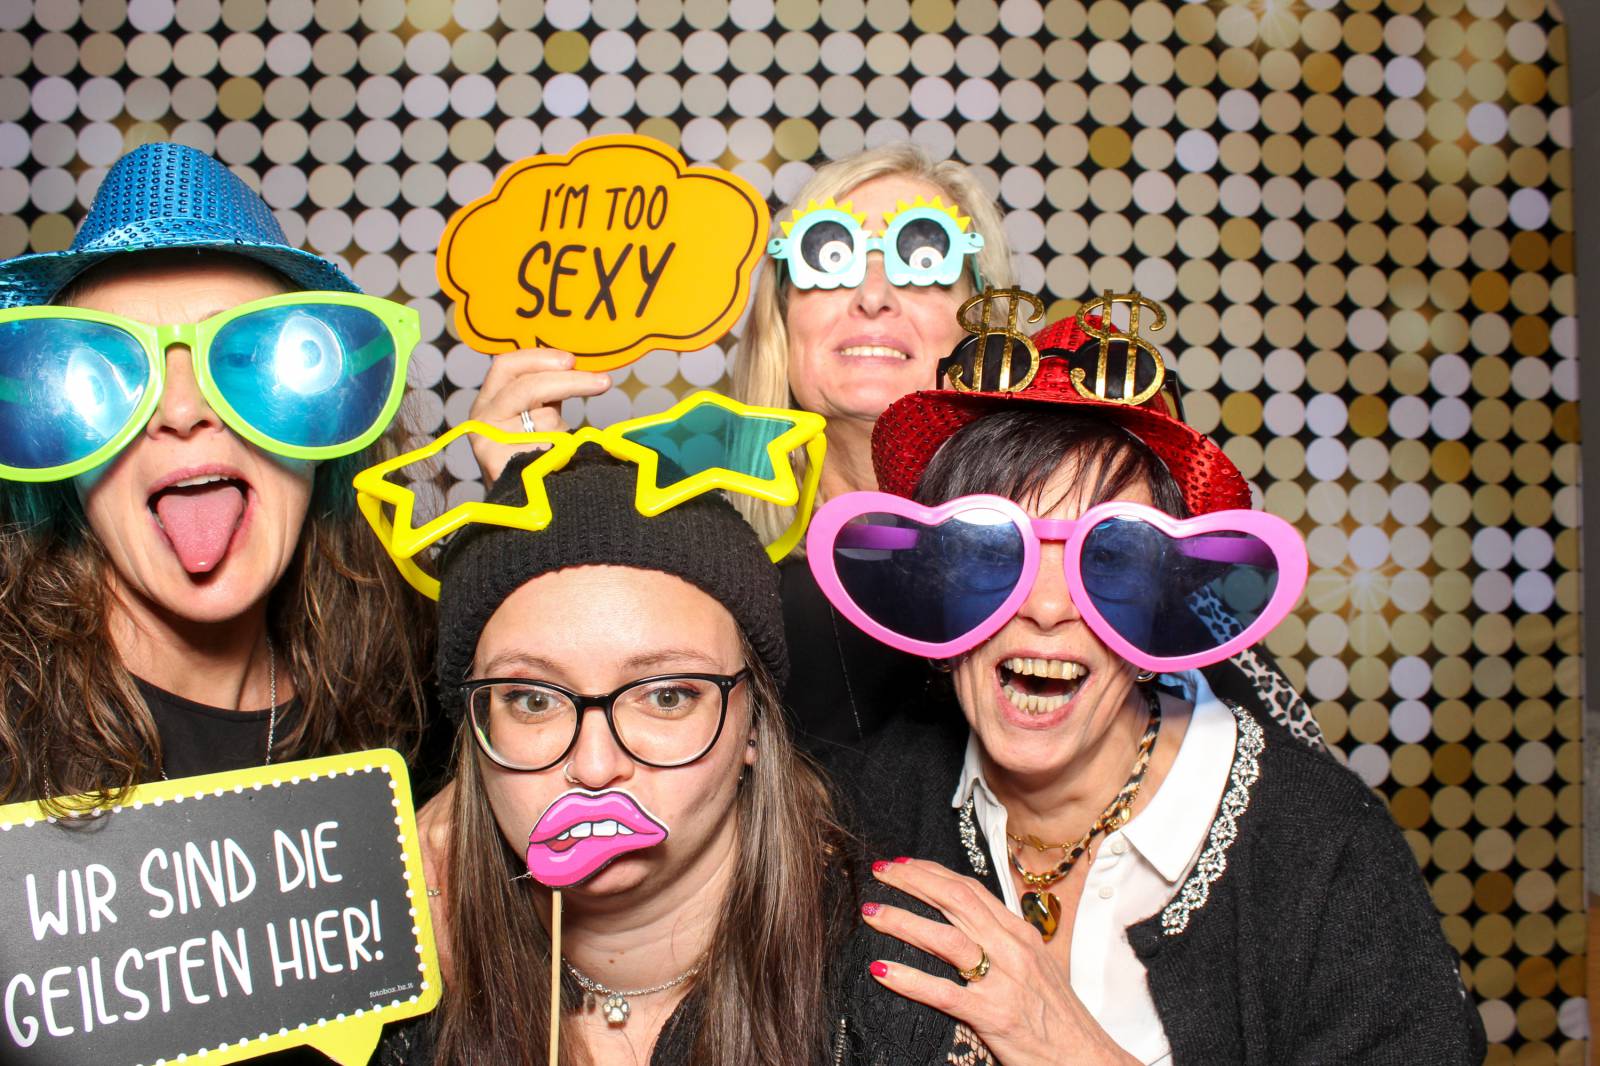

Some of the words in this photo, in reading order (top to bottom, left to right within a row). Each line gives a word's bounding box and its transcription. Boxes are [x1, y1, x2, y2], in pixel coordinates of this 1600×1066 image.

[540, 183, 589, 232] I'M
[606, 185, 668, 231] TOO
[516, 240, 676, 321] SEXY
[26, 863, 118, 941] WIR
[140, 838, 257, 919] SIND
[274, 821, 343, 893] DIE
[5, 927, 254, 1048] GEILSTEN
[266, 899, 385, 988] HIER!
